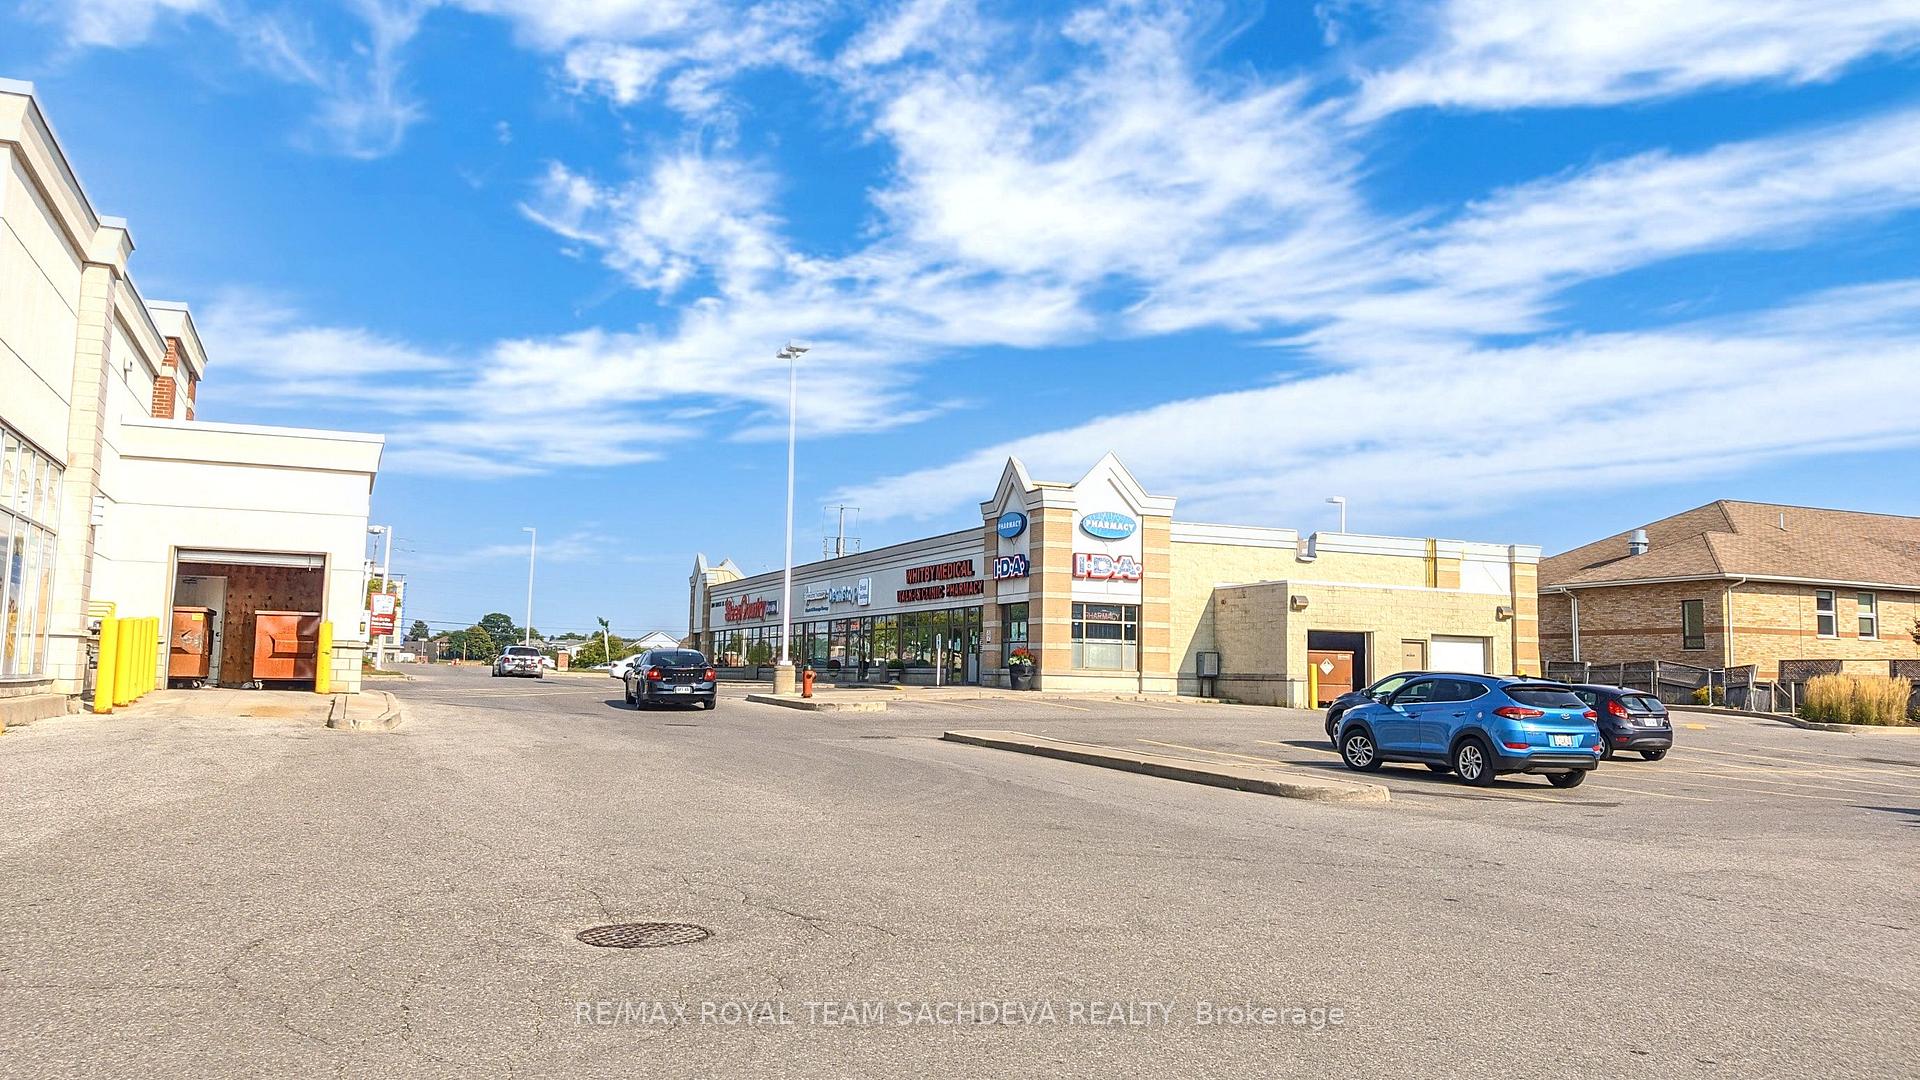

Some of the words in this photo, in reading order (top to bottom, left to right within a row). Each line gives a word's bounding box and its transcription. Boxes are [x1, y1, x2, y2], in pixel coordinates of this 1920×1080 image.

[1085, 519, 1135, 532] PHARMACY
[906, 565, 937, 585] WHITBY
[936, 559, 974, 581] MEDICAL
[946, 580, 984, 597] PHARMACY
